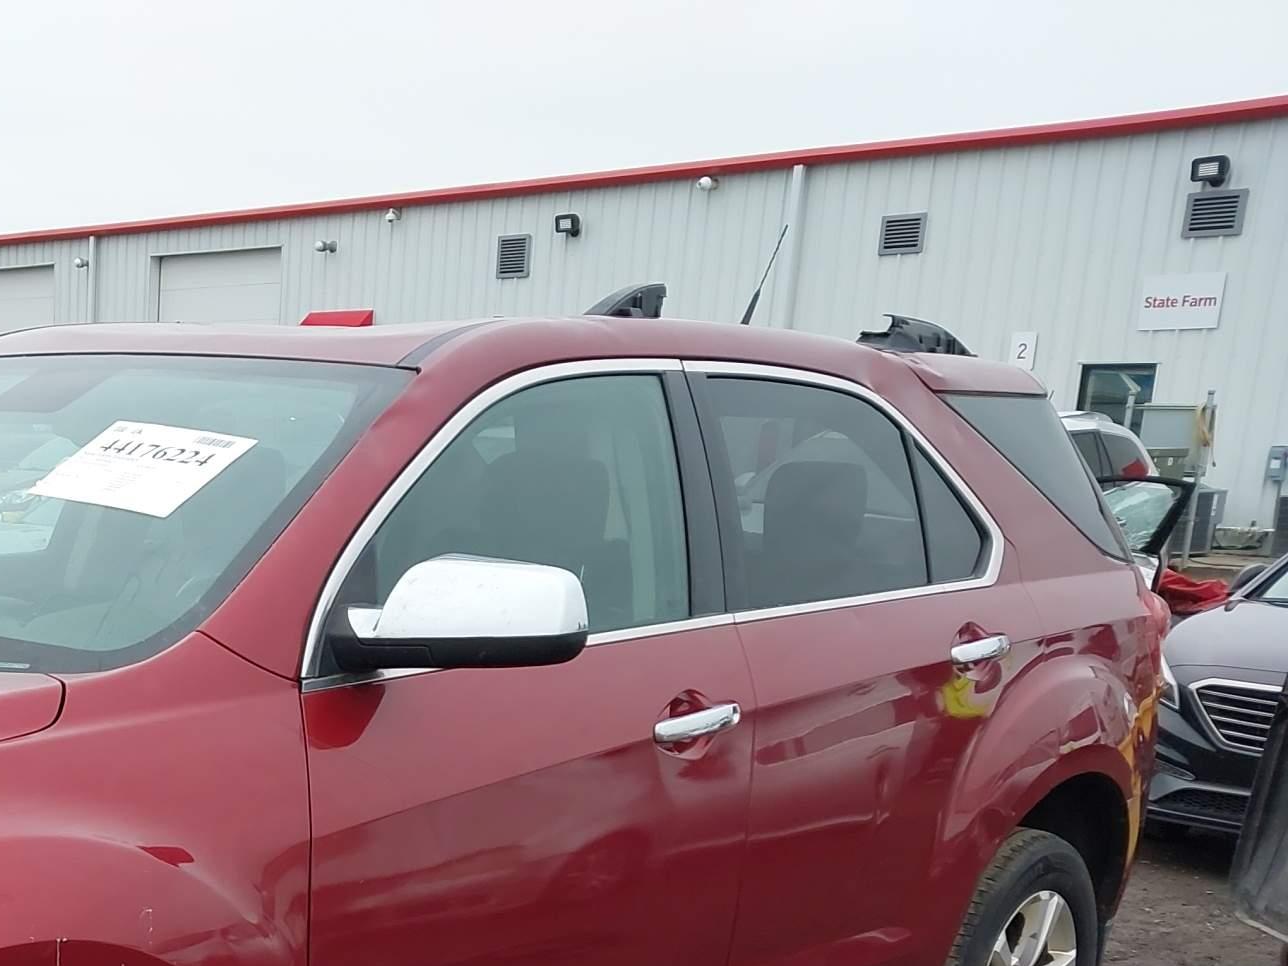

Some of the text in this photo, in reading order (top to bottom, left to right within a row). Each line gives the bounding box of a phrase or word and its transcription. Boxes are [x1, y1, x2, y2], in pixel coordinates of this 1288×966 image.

[1143, 295, 1218, 309] State Farm
[1016, 342, 1028, 360] 2
[99, 439, 216, 467] 44176224
